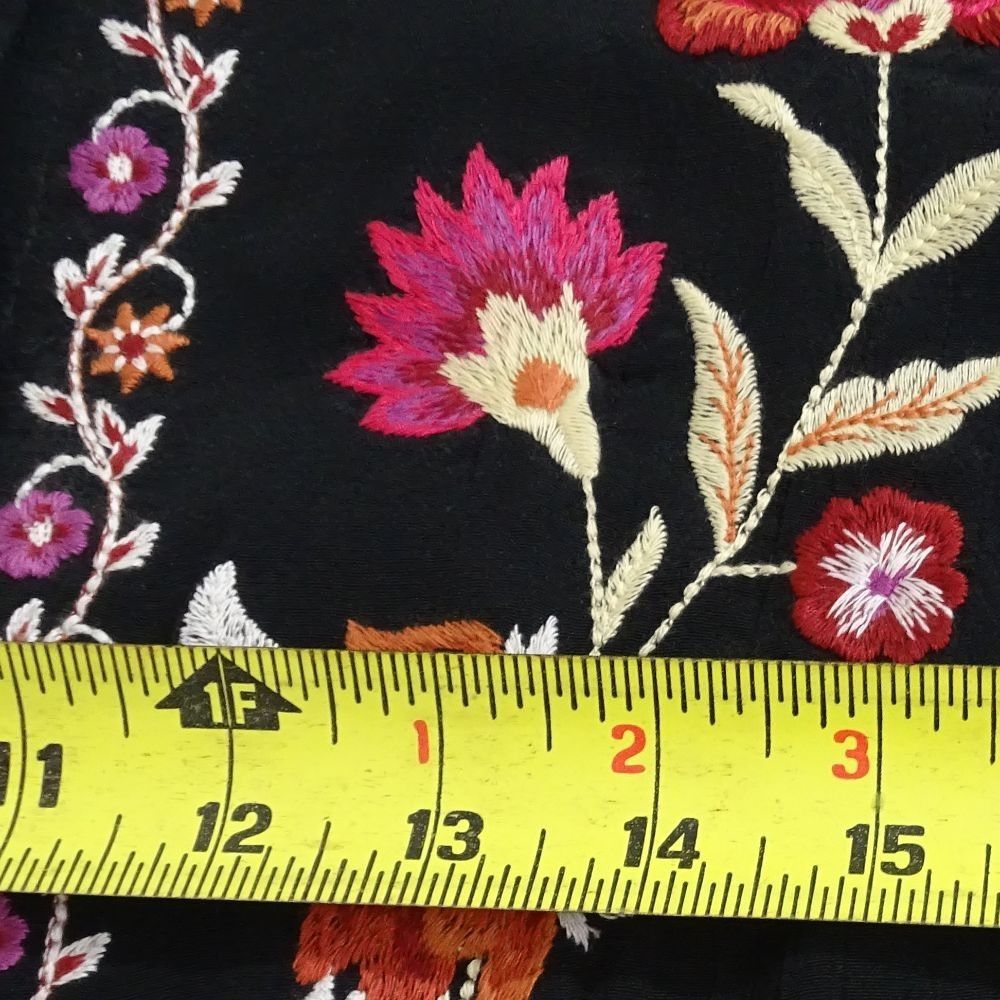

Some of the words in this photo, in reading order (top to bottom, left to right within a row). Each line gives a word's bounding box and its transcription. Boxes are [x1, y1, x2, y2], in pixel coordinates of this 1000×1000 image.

[205, 682, 257, 725] 1F
[413, 719, 430, 764] 1
[611, 724, 646, 774] 2
[831, 729, 870, 780] 3
[193, 801, 272, 854] 12
[405, 809, 485, 861] 13
[623, 816, 701, 869] 14
[845, 824, 926, 876] 15
